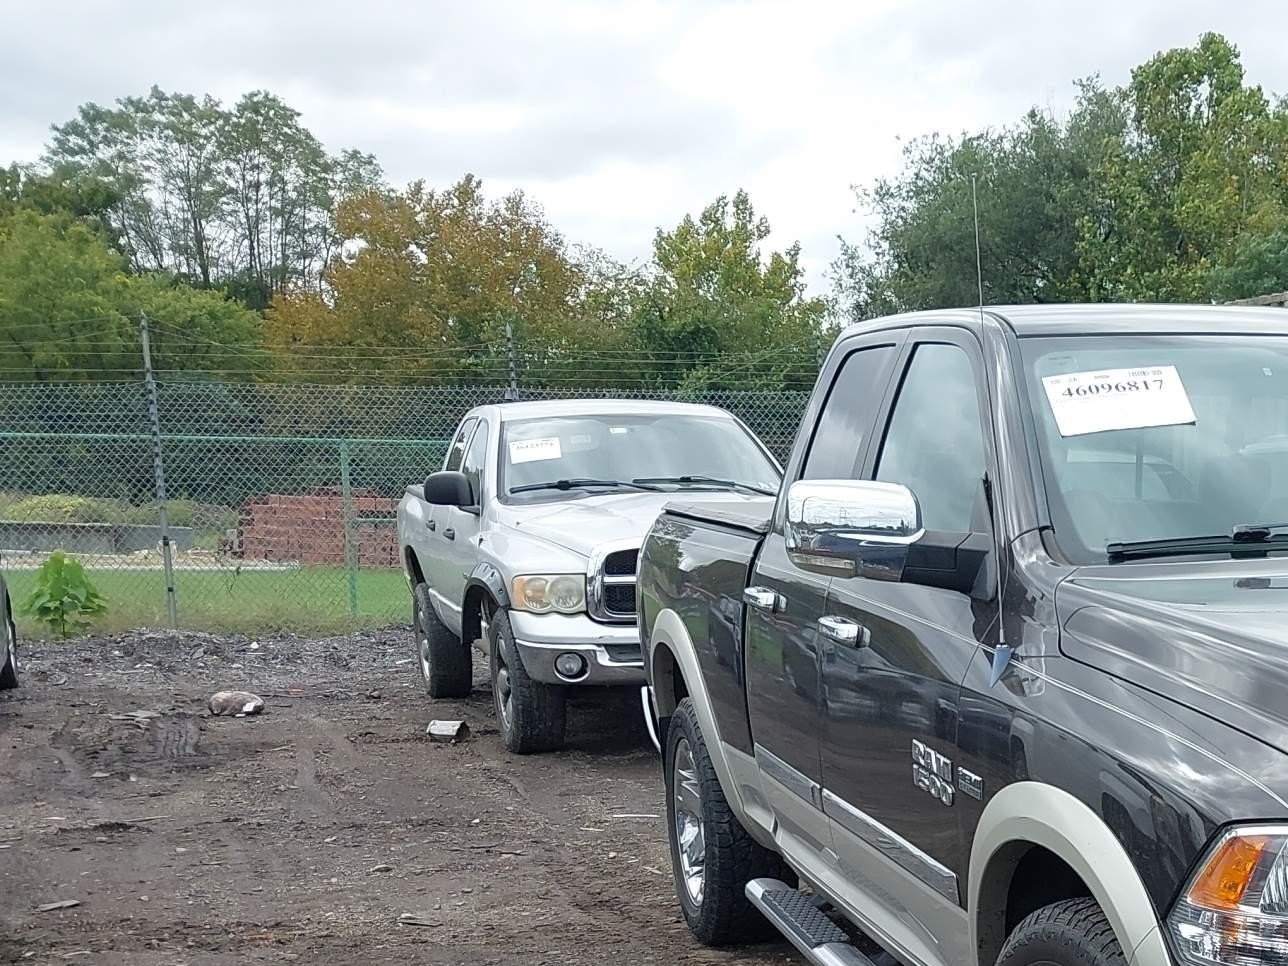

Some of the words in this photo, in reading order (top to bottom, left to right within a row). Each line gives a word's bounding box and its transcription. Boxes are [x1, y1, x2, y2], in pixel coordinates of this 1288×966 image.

[1062, 379, 1164, 397] 46096817
[912, 738, 952, 782] RAM
[913, 763, 956, 806] 1500
